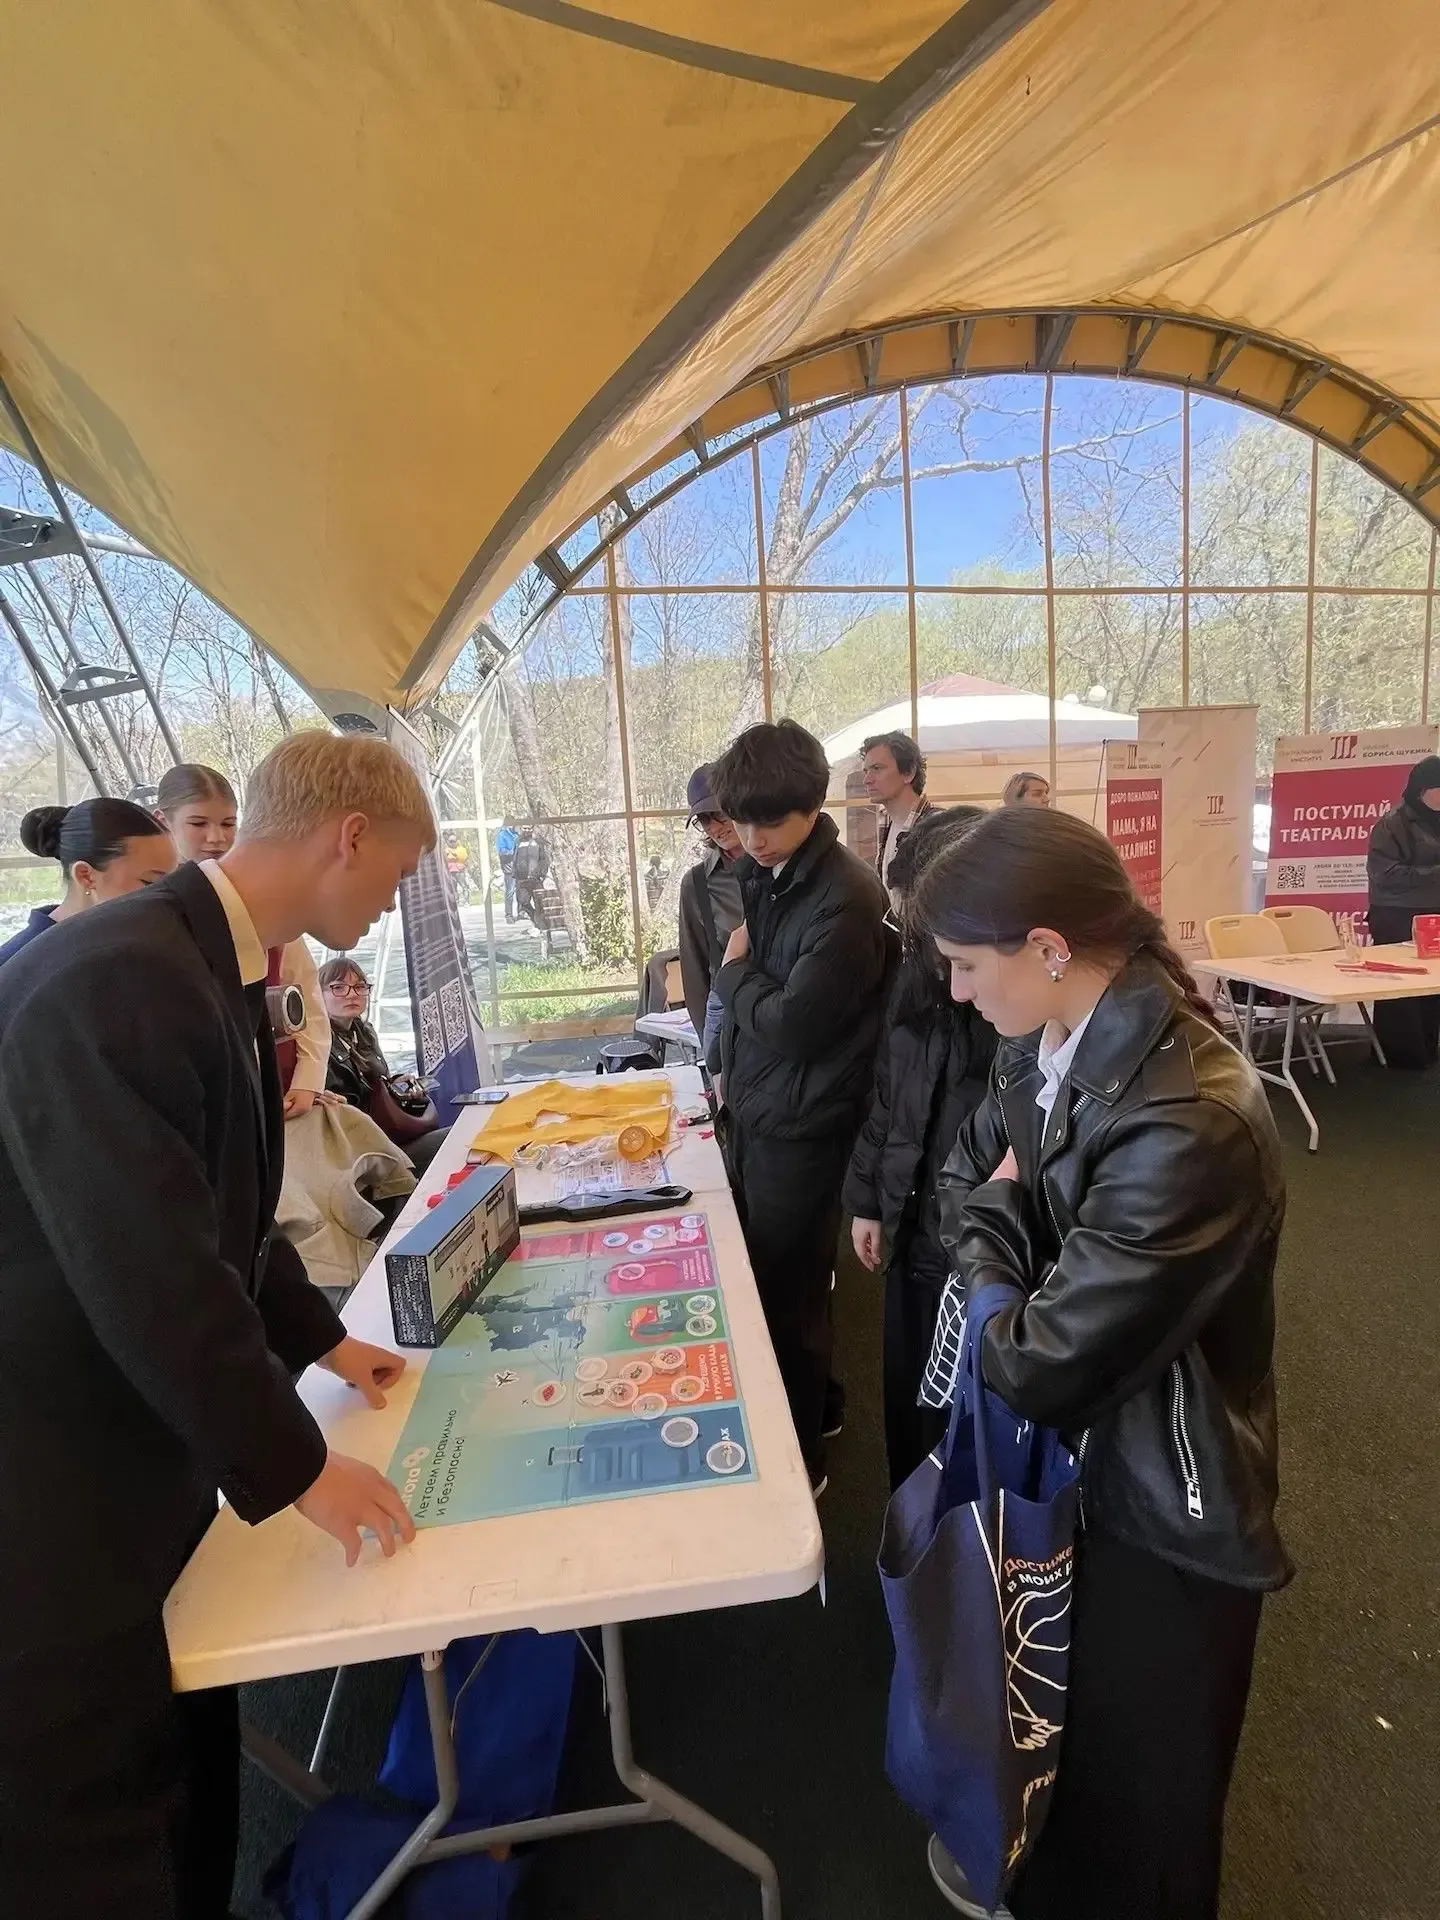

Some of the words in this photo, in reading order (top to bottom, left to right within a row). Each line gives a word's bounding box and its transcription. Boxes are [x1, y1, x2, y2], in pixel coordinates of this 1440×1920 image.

[1294, 800, 1392, 821] ПОСТУПАЙ
[1112, 817, 1139, 836] МАМА,
[1140, 816, 1146, 832] Я
[1146, 814, 1157, 832] НА
[1280, 826, 1375, 843] ТЕАТРАЛЬ
[1115, 839, 1156, 861] АХАЛИНЕ!
[414, 1467, 440, 1519] Летаем
[433, 1407, 457, 1465] правильно
[436, 1507, 446, 1516] и
[1006, 1580, 1018, 1593] в
[1018, 1567, 1063, 1586] моих
